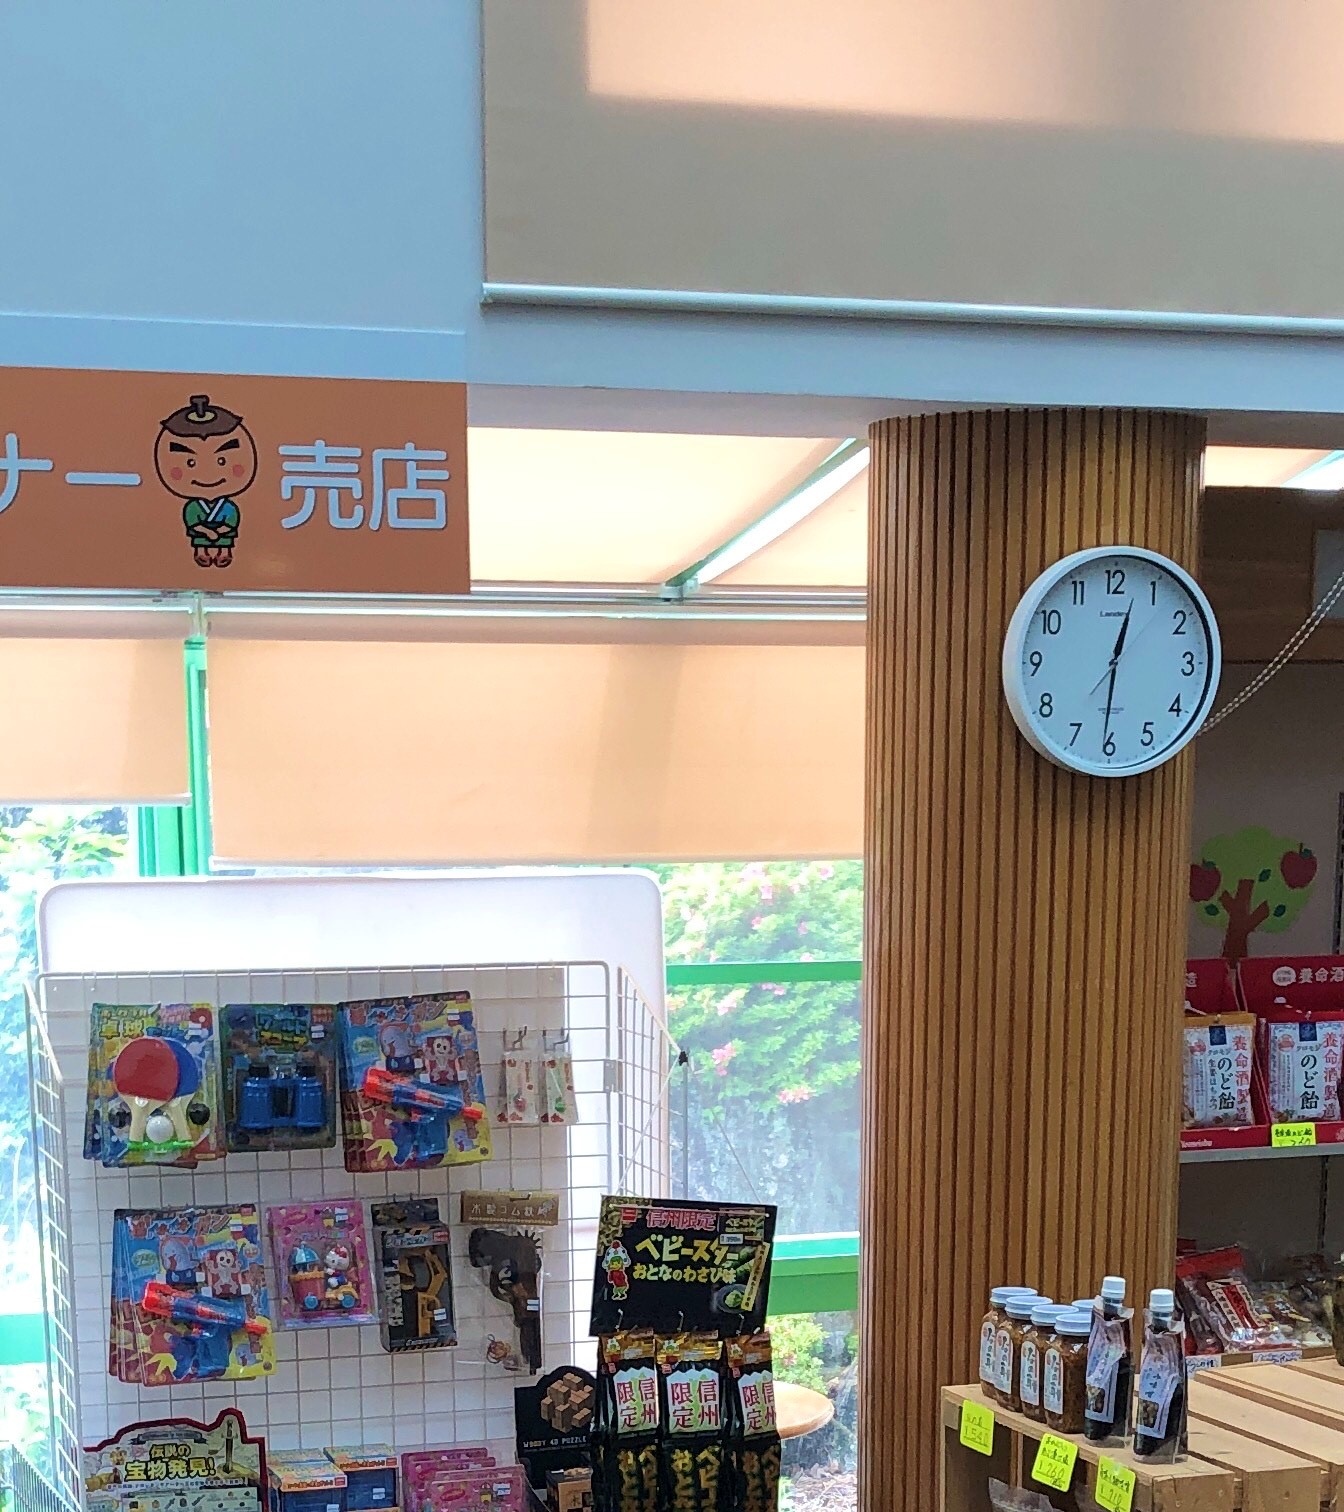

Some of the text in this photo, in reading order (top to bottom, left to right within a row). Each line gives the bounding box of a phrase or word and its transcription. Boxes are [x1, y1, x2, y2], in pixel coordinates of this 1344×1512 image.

[277, 439, 451, 534] 売店
[1071, 580, 1085, 606] 11
[1105, 569, 1126, 595] 12
[1149, 580, 1158, 606] 1
[1041, 609, 1062, 635] 10
[1172, 609, 1188, 635] 2
[1029, 650, 1044, 677] 9
[1180, 650, 1195, 677] 3
[1038, 692, 1054, 718] 8
[1167, 692, 1183, 718] 4
[1068, 723, 1083, 747] 7
[1102, 731, 1117, 757] 6
[1140, 721, 1155, 747] 5
[1216, 1057, 1236, 1111] のど飴
[1232, 1034, 1252, 1123] 養命酒製造
[1299, 1053, 1321, 1111] のど飴
[1322, 1031, 1341, 1120] 養命酒製造
[645, 1209, 717, 1232] 信州限定
[634, 1233, 740, 1266] ベビースター
[632, 1262, 738, 1285] おとなのわさび味
[616, 1381, 637, 1430] 限定
[670, 1382, 694, 1428] 限定
[696, 1379, 718, 1426] 信州
[741, 1386, 762, 1431] 限定
[149, 1442, 192, 1459] 伝説の
[125, 1456, 218, 1482] 宝物発見!
